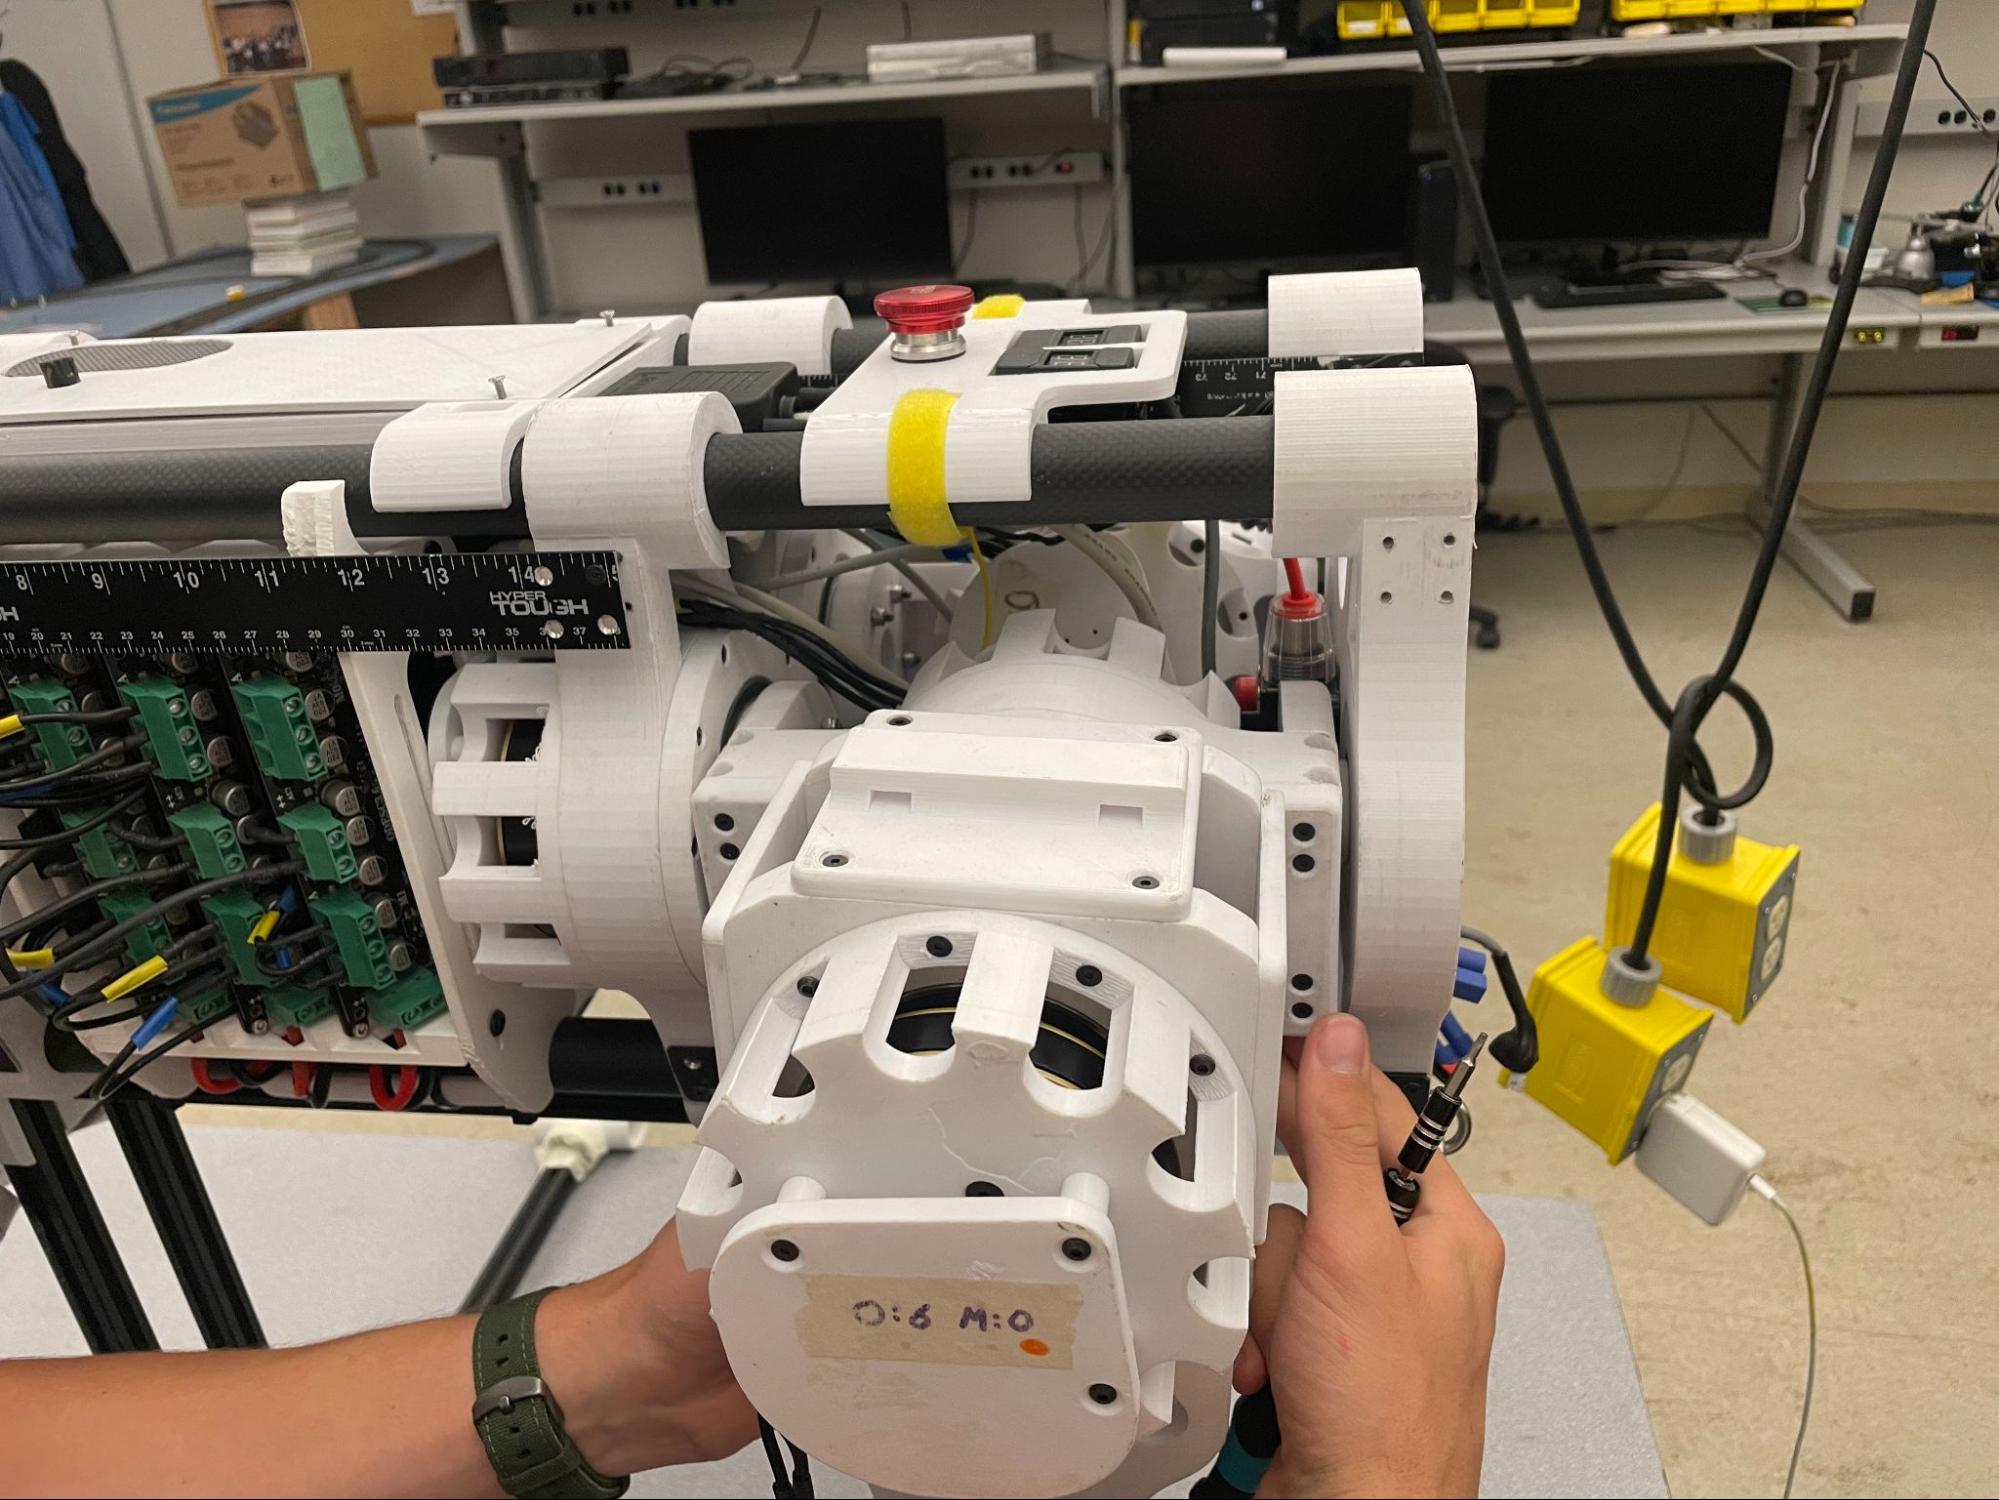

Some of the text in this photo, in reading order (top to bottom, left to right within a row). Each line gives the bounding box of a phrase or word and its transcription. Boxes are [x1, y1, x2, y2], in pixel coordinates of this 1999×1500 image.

[16, 574, 27, 590] 8
[92, 573, 103, 589] 9
[173, 571, 200, 588] 10
[254, 570, 279, 587] 11
[337, 569, 365, 586] 12
[421, 567, 449, 584] 13
[508, 566, 535, 583] 14
[490, 591, 546, 600] HYPER
[492, 599, 589, 616] TOUGH
[30, 632, 44, 640] 20
[60, 632, 72, 640] 21
[90, 631, 104, 640] 22
[120, 631, 134, 640] 23
[151, 631, 163, 640] 24
[182, 631, 195, 640] 25
[212, 631, 226, 639] 26
[244, 631, 257, 639] 27
[340, 629, 354, 638] 30
[373, 629, 386, 638] 31
[406, 628, 420, 637] 32
[439, 628, 452, 637] 33
[472, 627, 486, 637] 34
[505, 627, 519, 636] 35
[573, 626, 587, 636] 37
